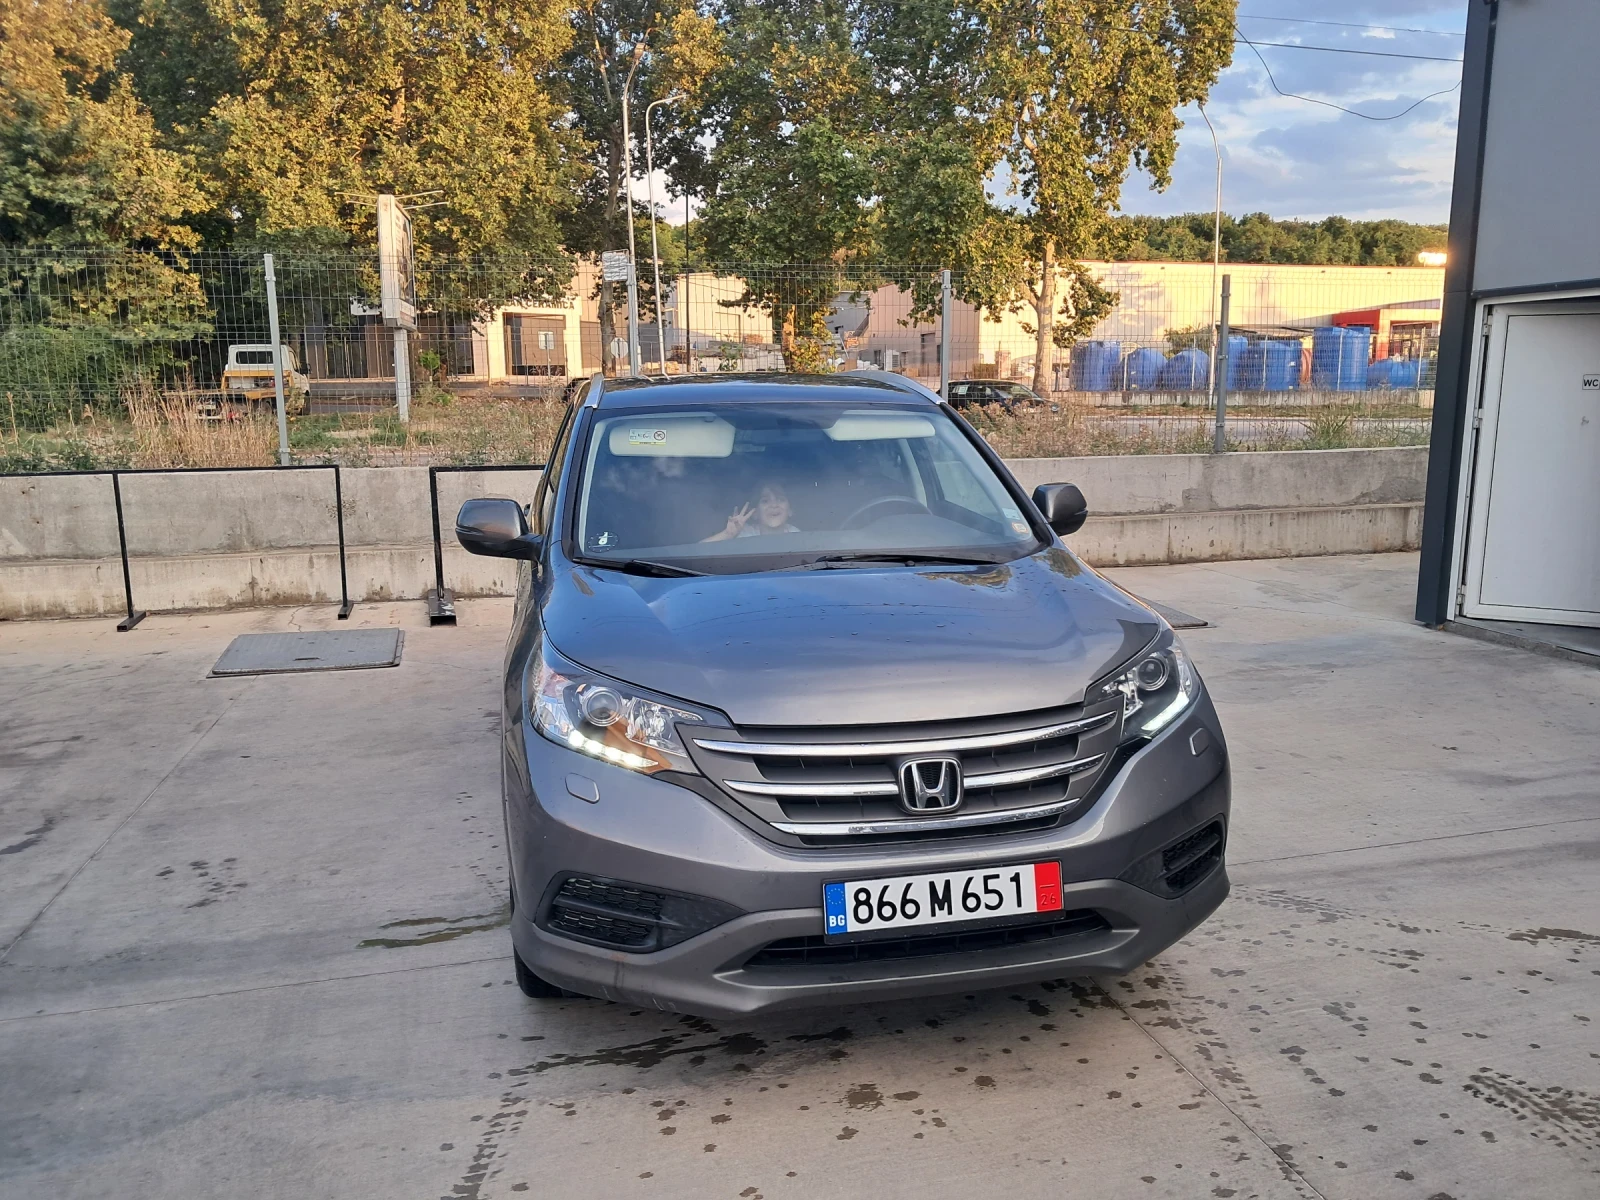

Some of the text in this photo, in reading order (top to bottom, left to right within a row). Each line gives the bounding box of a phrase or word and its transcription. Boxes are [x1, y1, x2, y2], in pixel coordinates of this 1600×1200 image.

[1583, 379, 1599, 387] WC
[852, 871, 1023, 924] 866 M 651
[1040, 892, 1057, 906] 26
[829, 914, 846, 927] BG
